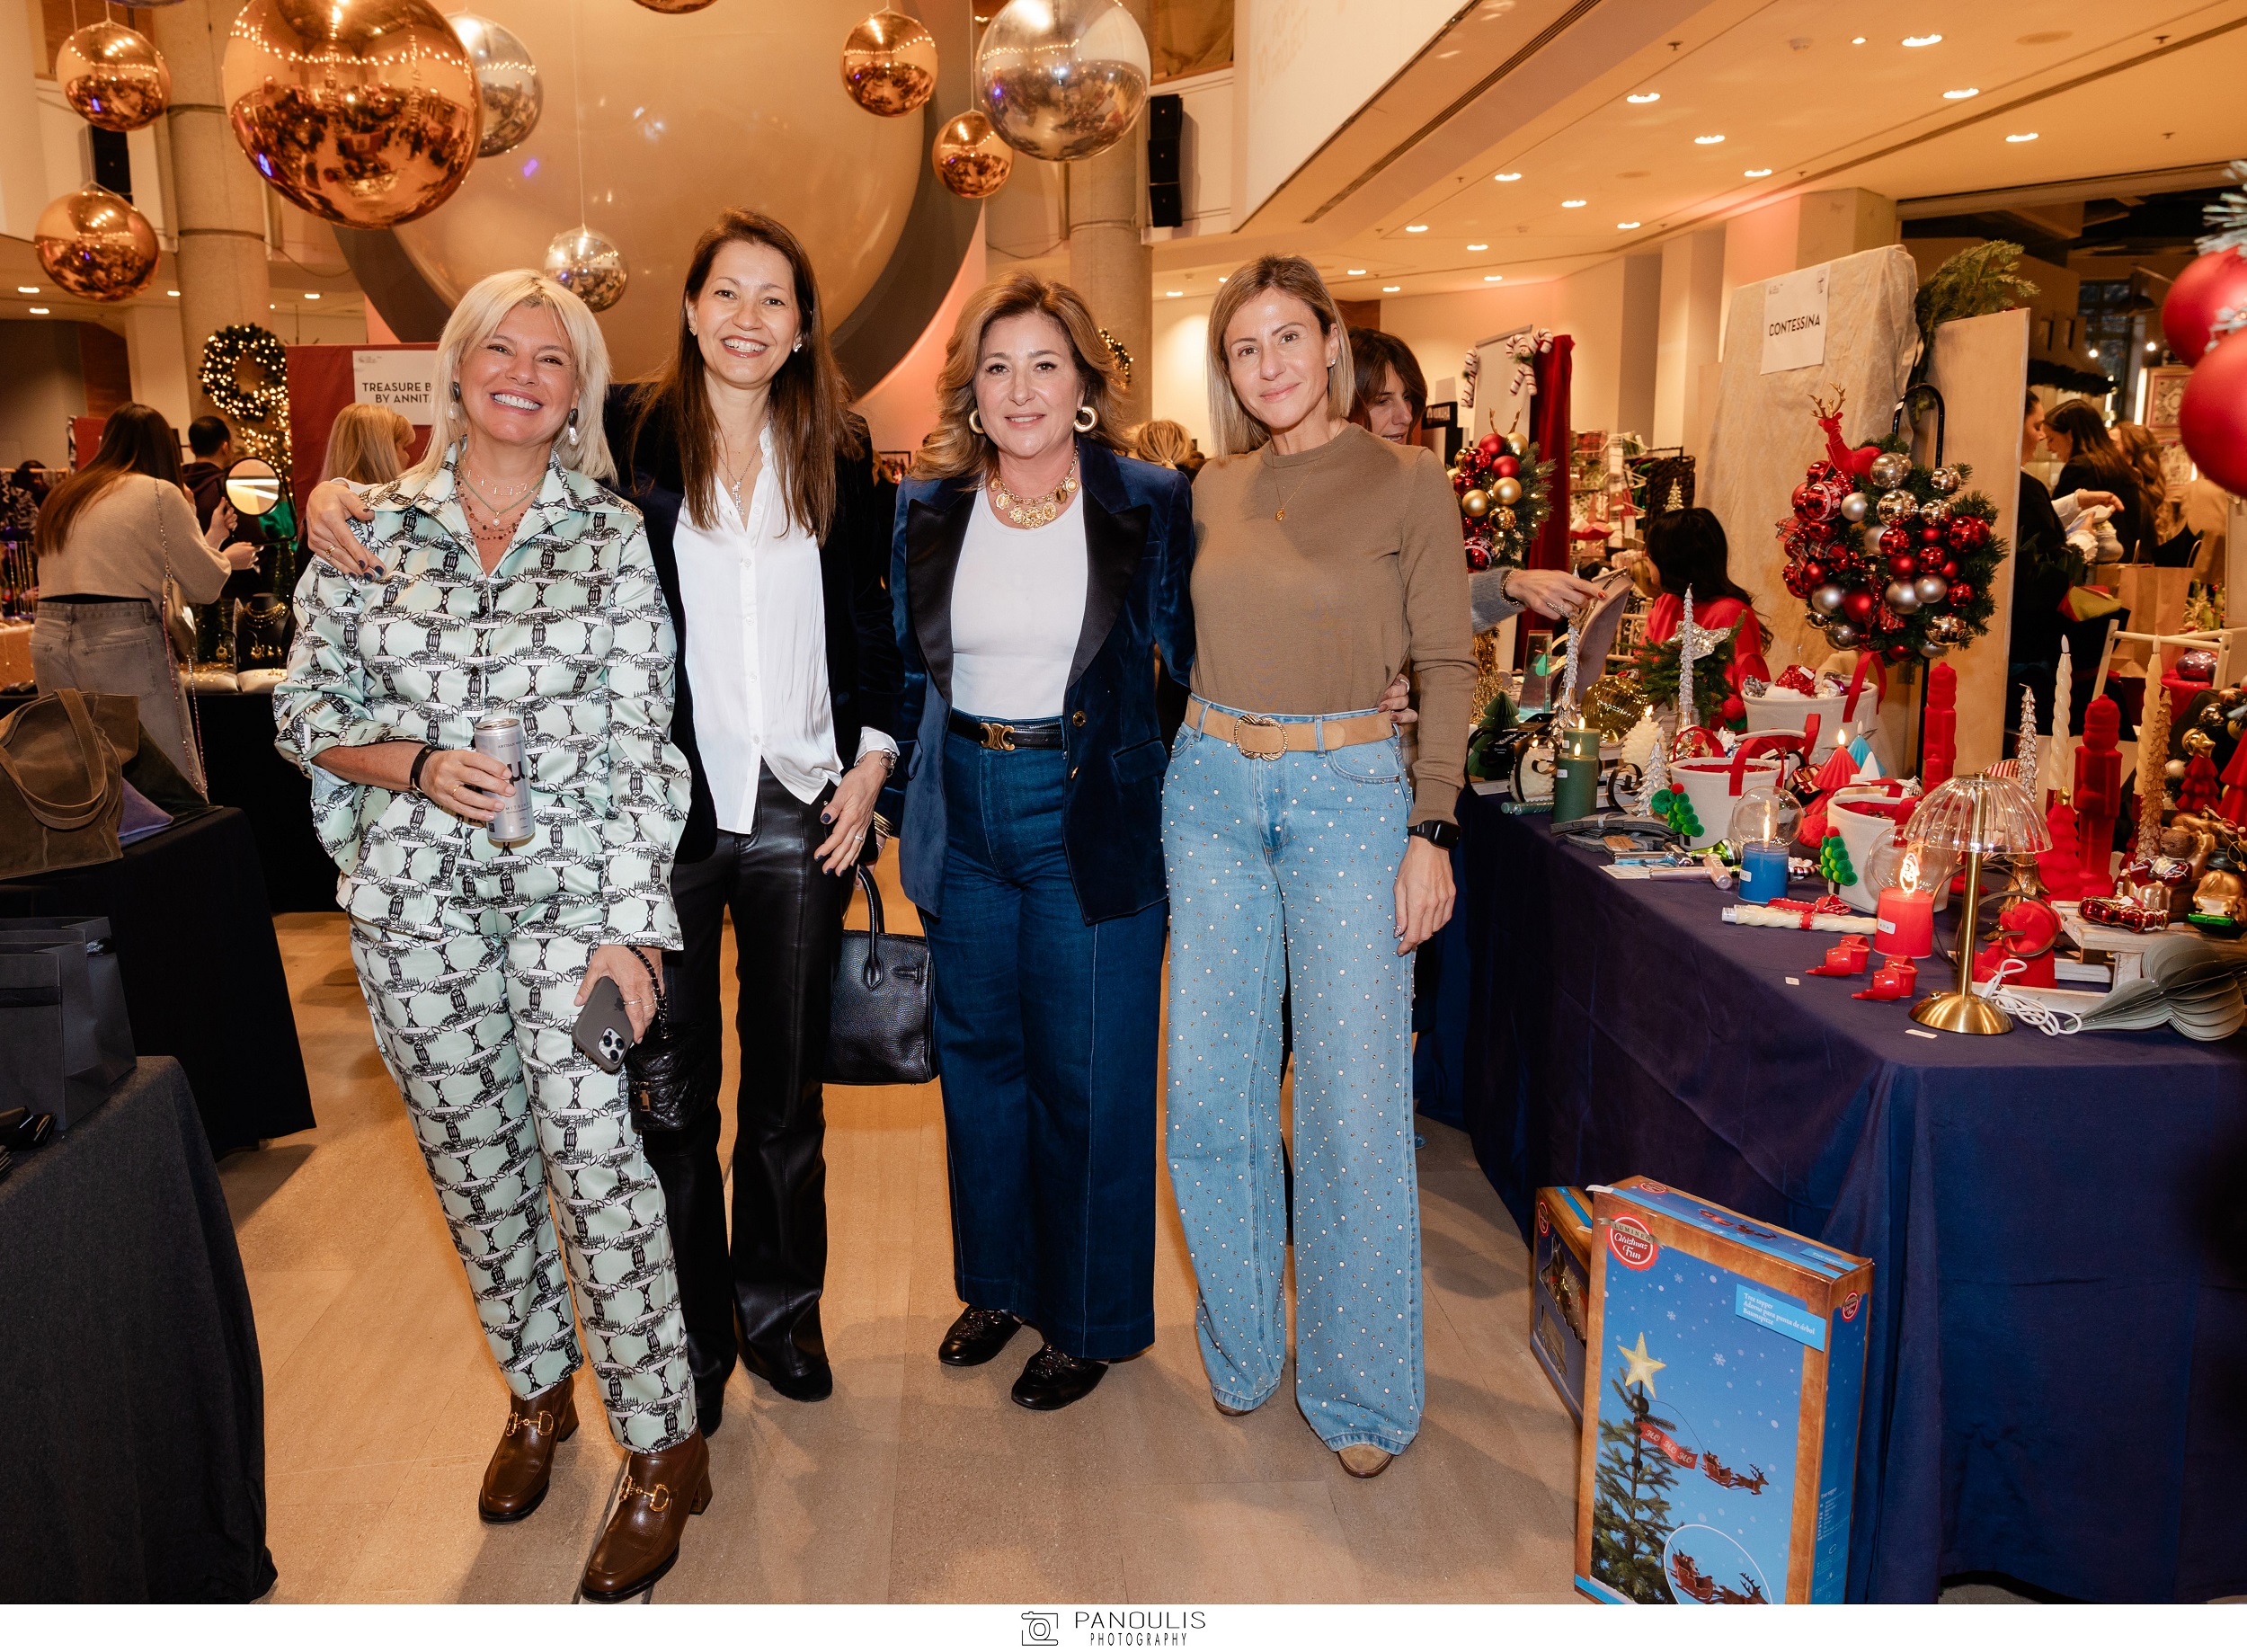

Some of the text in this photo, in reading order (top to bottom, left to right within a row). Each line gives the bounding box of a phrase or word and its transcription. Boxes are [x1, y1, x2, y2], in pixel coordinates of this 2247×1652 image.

[1769, 314, 1821, 337] CONTESSINA
[362, 382, 422, 392] TREASURE
[375, 394, 432, 404] BY ANNIT
[1614, 1223, 1651, 1241] LUMINEO
[1614, 1232, 1648, 1250] Christmas
[1622, 1245, 1641, 1259] Fun
[1744, 1292, 1773, 1310] Tree topper
[1743, 1308, 1774, 1326] Baumspitze
[1744, 1301, 1763, 1312] Adorno
[1763, 1310, 1775, 1319] para
[1793, 1320, 1799, 1328] de
